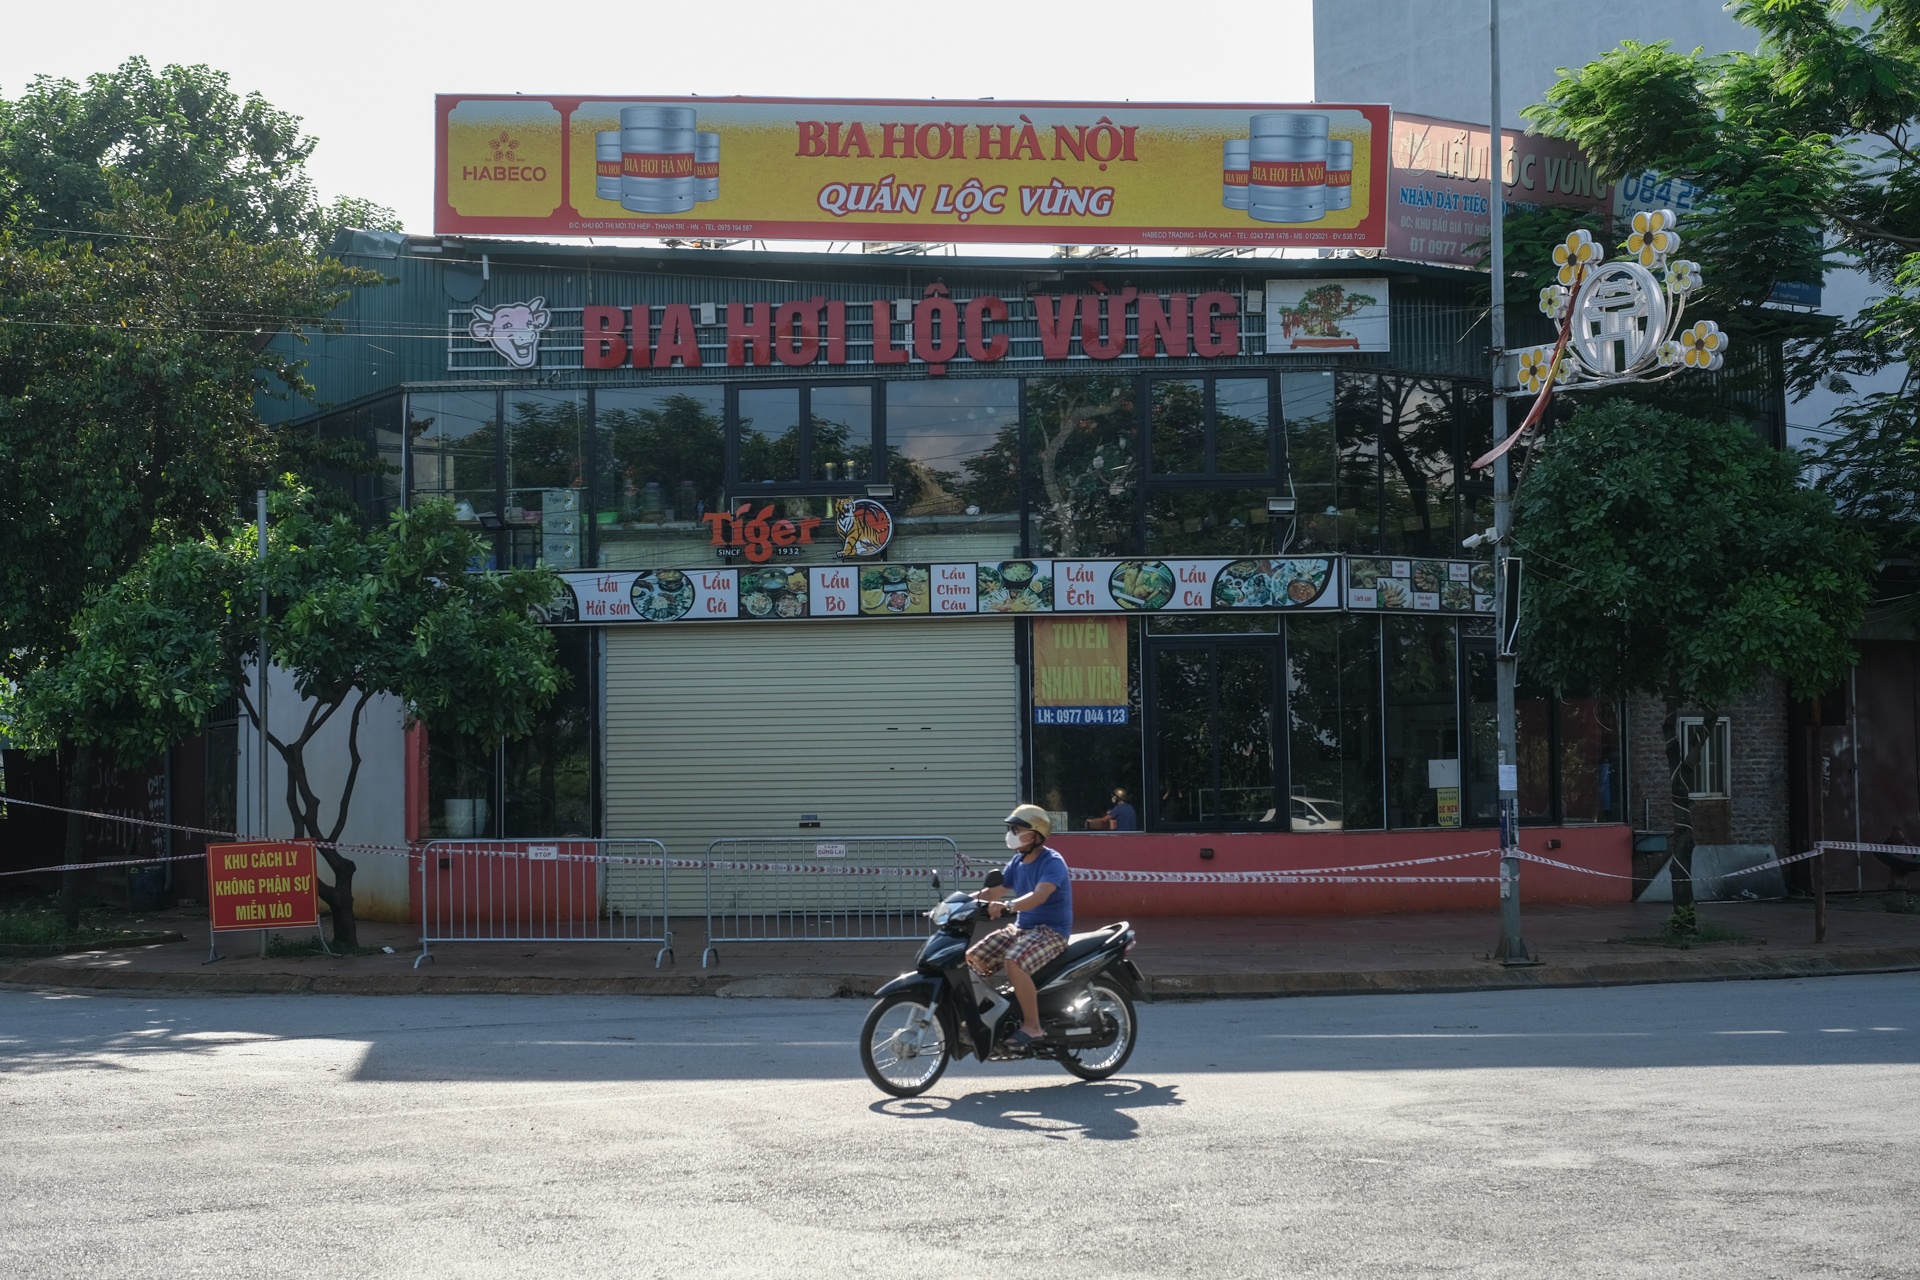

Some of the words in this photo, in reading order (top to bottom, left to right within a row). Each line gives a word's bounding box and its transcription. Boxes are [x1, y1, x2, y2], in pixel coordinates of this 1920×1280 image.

[794, 120, 875, 159] BIA
[879, 120, 968, 160] HƠI
[976, 113, 1046, 161] HÀ
[1051, 115, 1139, 171] NỘI
[462, 165, 547, 182] HABECO
[597, 164, 608, 174] BIA
[624, 158, 639, 173] BIA
[640, 158, 658, 174] HƠI
[660, 156, 675, 174] HÀ
[676, 156, 692, 176] NỘI
[697, 164, 707, 176] HÀ
[1252, 166, 1267, 181] BIA
[1269, 167, 1288, 183] HƠI
[1290, 164, 1306, 182] HÀ
[1307, 164, 1324, 184] NỘI
[1436, 130, 1484, 183] LẨU
[1488, 143, 1537, 197] ỘC
[1543, 151, 1609, 200] VỪNG
[1225, 173, 1235, 183] BIA
[1328, 173, 1339, 184] HÀ
[818, 173, 930, 217] QUÁN
[933, 177, 1008, 222] LỘC
[1018, 177, 1115, 217] VỪNG
[1399, 184, 1435, 212] NHẬN
[1436, 187, 1460, 215] ĐẶT
[1462, 191, 1488, 219] TIỆC
[1415, 217, 1431, 231] KHU
[1142, 231, 1168, 239] HABECO
[1168, 231, 1194, 239] TRADING
[1409, 237, 1426, 253] ĐT
[1428, 239, 1458, 256] 0977
[582, 301, 702, 369] BIA
[726, 296, 846, 367] HƠI
[872, 282, 1009, 376] LỘC
[1034, 281, 1240, 360] VỪNG
[703, 503, 822, 563] Tiger
[717, 548, 741, 556] SINCE
[778, 547, 799, 555] 1932
[596, 572, 619, 593] Lẩu
[702, 571, 731, 591] Lẩu
[820, 570, 850, 589] Lẩu
[941, 565, 966, 581] Lẩu
[1066, 565, 1095, 584] Lẩu
[1179, 565, 1207, 584] Lẩu
[936, 582, 971, 596] Chim
[1066, 584, 1095, 606] Ếch
[1183, 588, 1204, 607] Cá
[585, 595, 607, 617] Hải
[609, 598, 631, 616] sản
[706, 593, 728, 613] Gà
[825, 592, 846, 612] Bò
[941, 595, 967, 611] Câu
[1052, 617, 1109, 650] TUYỂN
[1041, 659, 1083, 700] NHÂN
[1087, 659, 1121, 700] VIÊN
[1037, 709, 1054, 723] LH:
[1056, 709, 1081, 723] 0977
[1084, 709, 1104, 723] 044
[1106, 708, 1125, 723] 123
[224, 853, 248, 870] KHU
[251, 850, 283, 869] CÁCH
[285, 850, 298, 866] LY
[215, 877, 256, 896] KHÔNG
[258, 874, 291, 896] PHẬN
[294, 874, 311, 895] SỰ
[235, 899, 267, 921] MIỄN
[269, 900, 293, 919] VÀO
